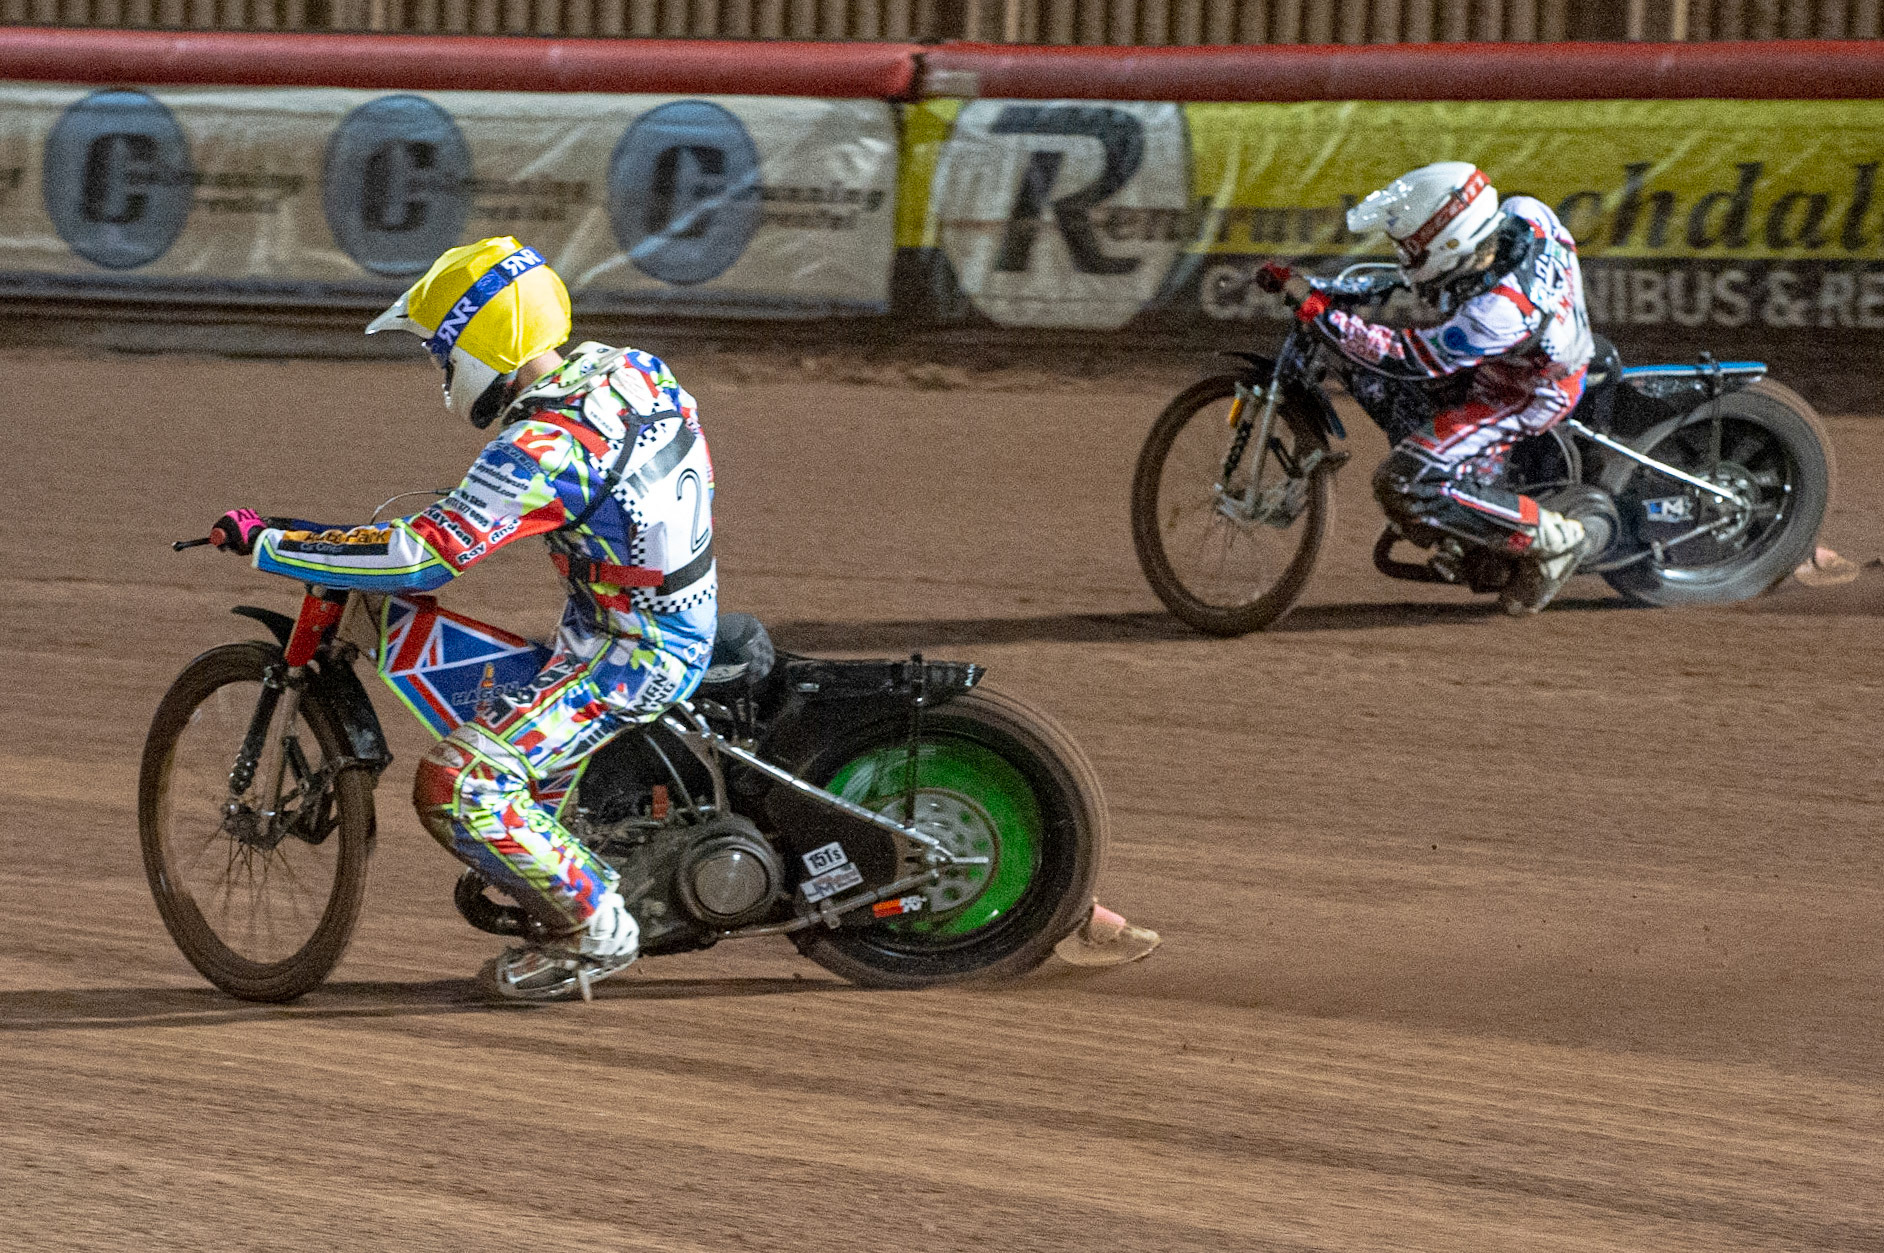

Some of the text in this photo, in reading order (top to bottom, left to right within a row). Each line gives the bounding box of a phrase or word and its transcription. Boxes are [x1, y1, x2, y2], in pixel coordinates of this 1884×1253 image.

[80, 132, 158, 223] C
[361, 137, 439, 232] C
[457, 543, 485, 563] Ray
[676, 467, 710, 555] 2
